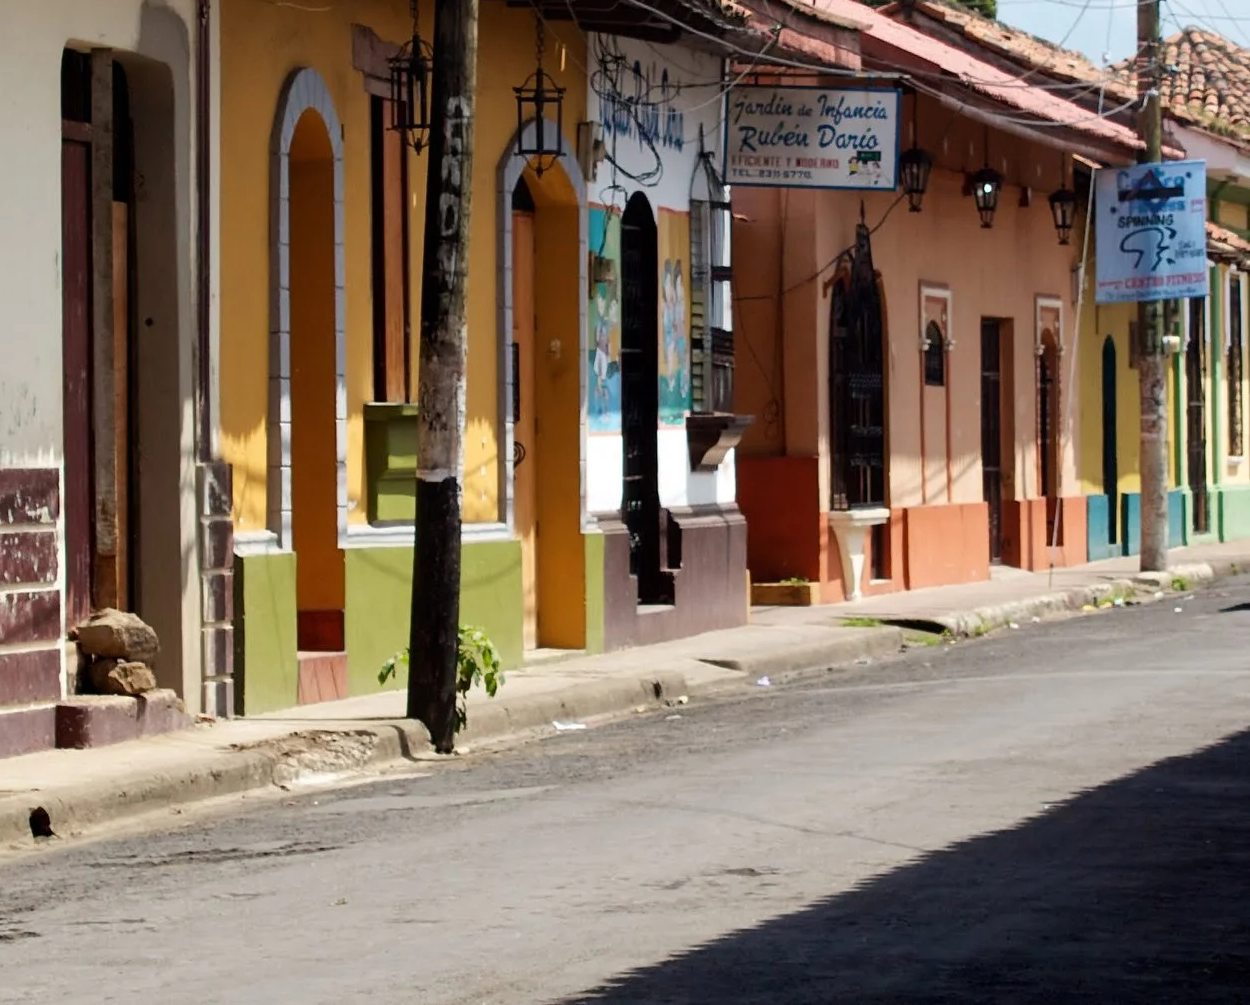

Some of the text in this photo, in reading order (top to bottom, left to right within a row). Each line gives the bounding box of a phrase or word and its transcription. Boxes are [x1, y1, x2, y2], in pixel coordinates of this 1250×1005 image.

[797, 104, 812, 117] de
[817, 94, 888, 125] Infancia
[738, 121, 879, 152] Rubén Darío
[731, 154, 781, 168] EFICIENTE
[786, 157, 793, 168] Y
[1118, 214, 1174, 228] SPINNING
